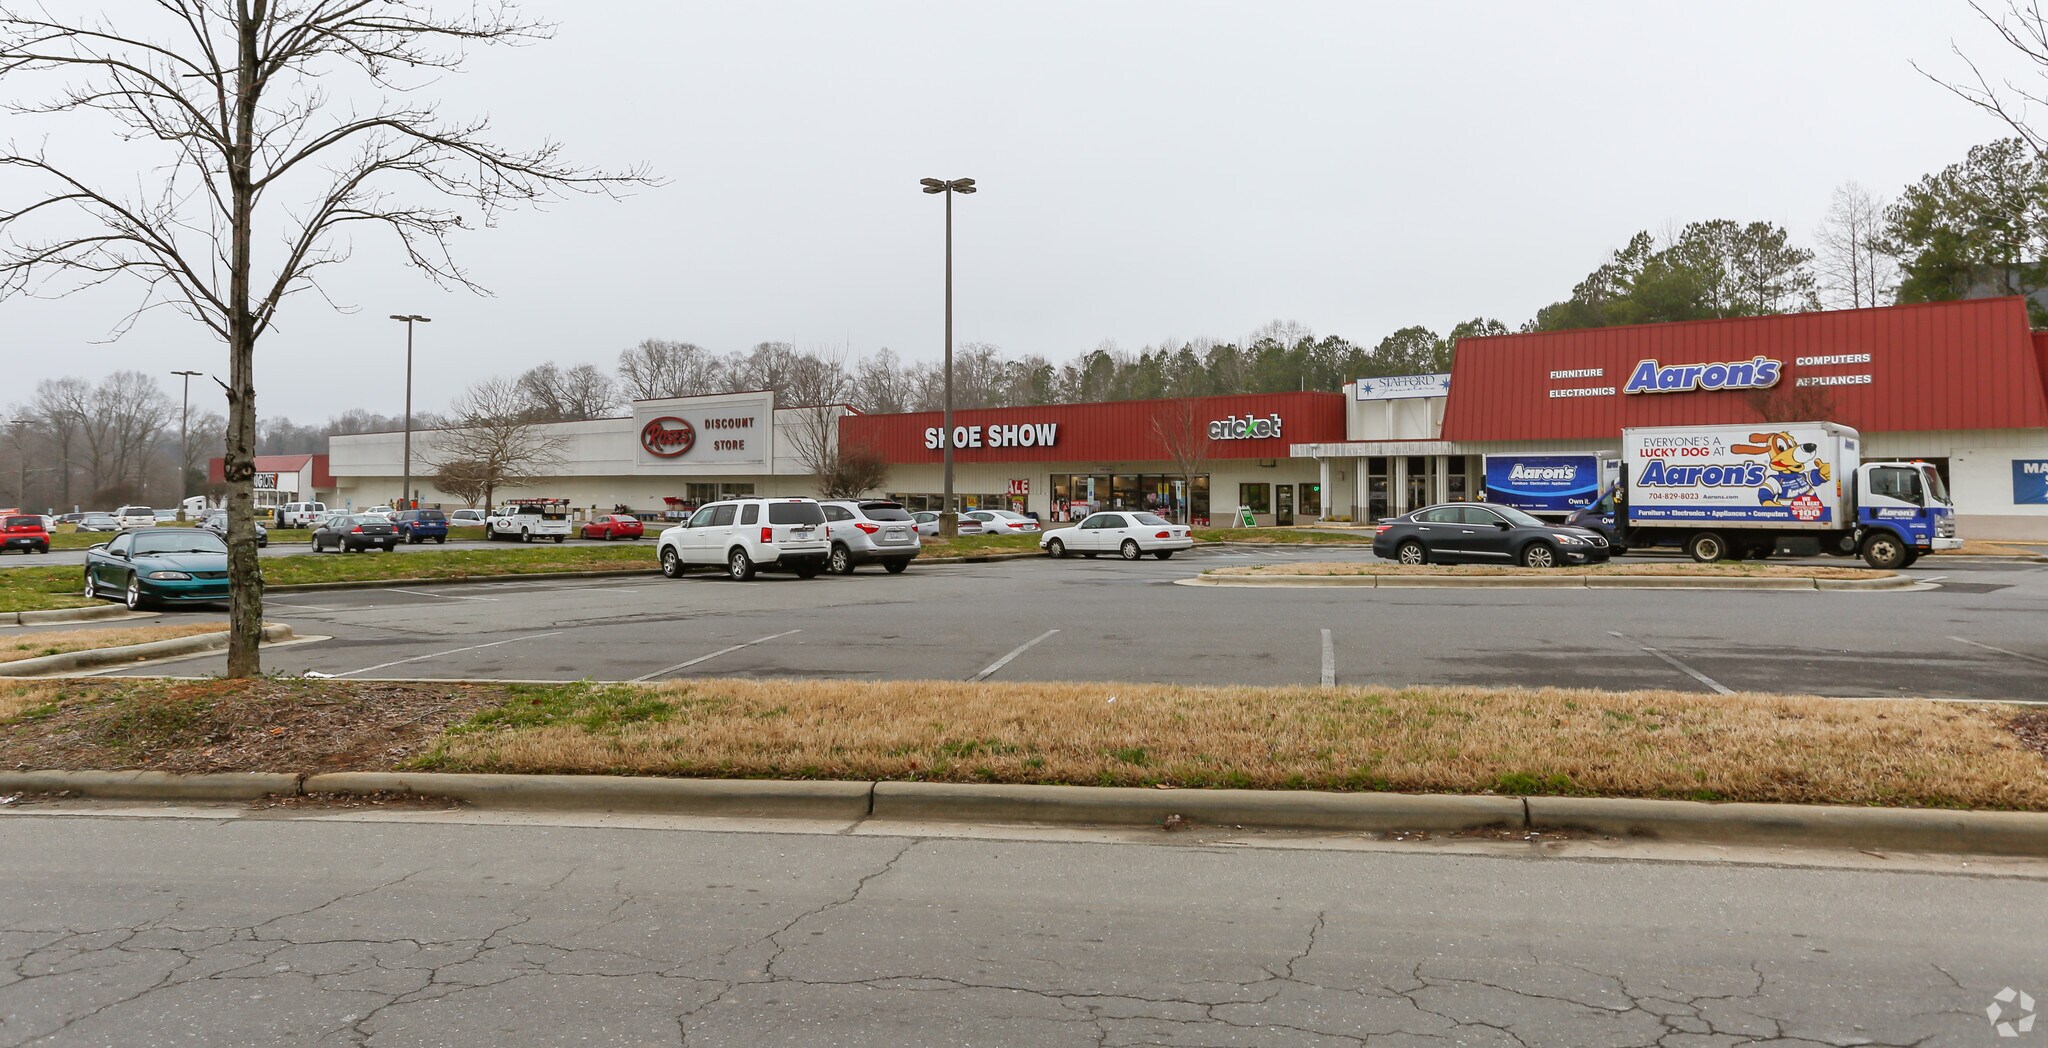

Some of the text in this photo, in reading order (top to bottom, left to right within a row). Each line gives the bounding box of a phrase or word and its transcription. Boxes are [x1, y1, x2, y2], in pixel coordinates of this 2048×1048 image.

[1796, 353, 1871, 366] COMPUTERS
[1550, 368, 1603, 379] FURNITURE
[1623, 356, 1782, 394] Aaron's
[1796, 374, 1872, 387] APPLIANCES
[1549, 387, 1616, 398] ELECTRONICS
[704, 417, 755, 430] DISCOUNT
[1208, 413, 1281, 440] cricket
[987, 423, 1056, 447] SHOW
[1643, 436, 1721, 447] EVERYONE'S A
[714, 439, 745, 451] STORE
[1640, 446, 1726, 457] LUCKY DOG AT
[1508, 463, 1577, 481] Aaron's
[1637, 459, 1767, 487] Aaron's
[1648, 492, 1699, 500] 704-829-8023
[1638, 509, 1789, 518] Furniture Electronics Appliances Computers
